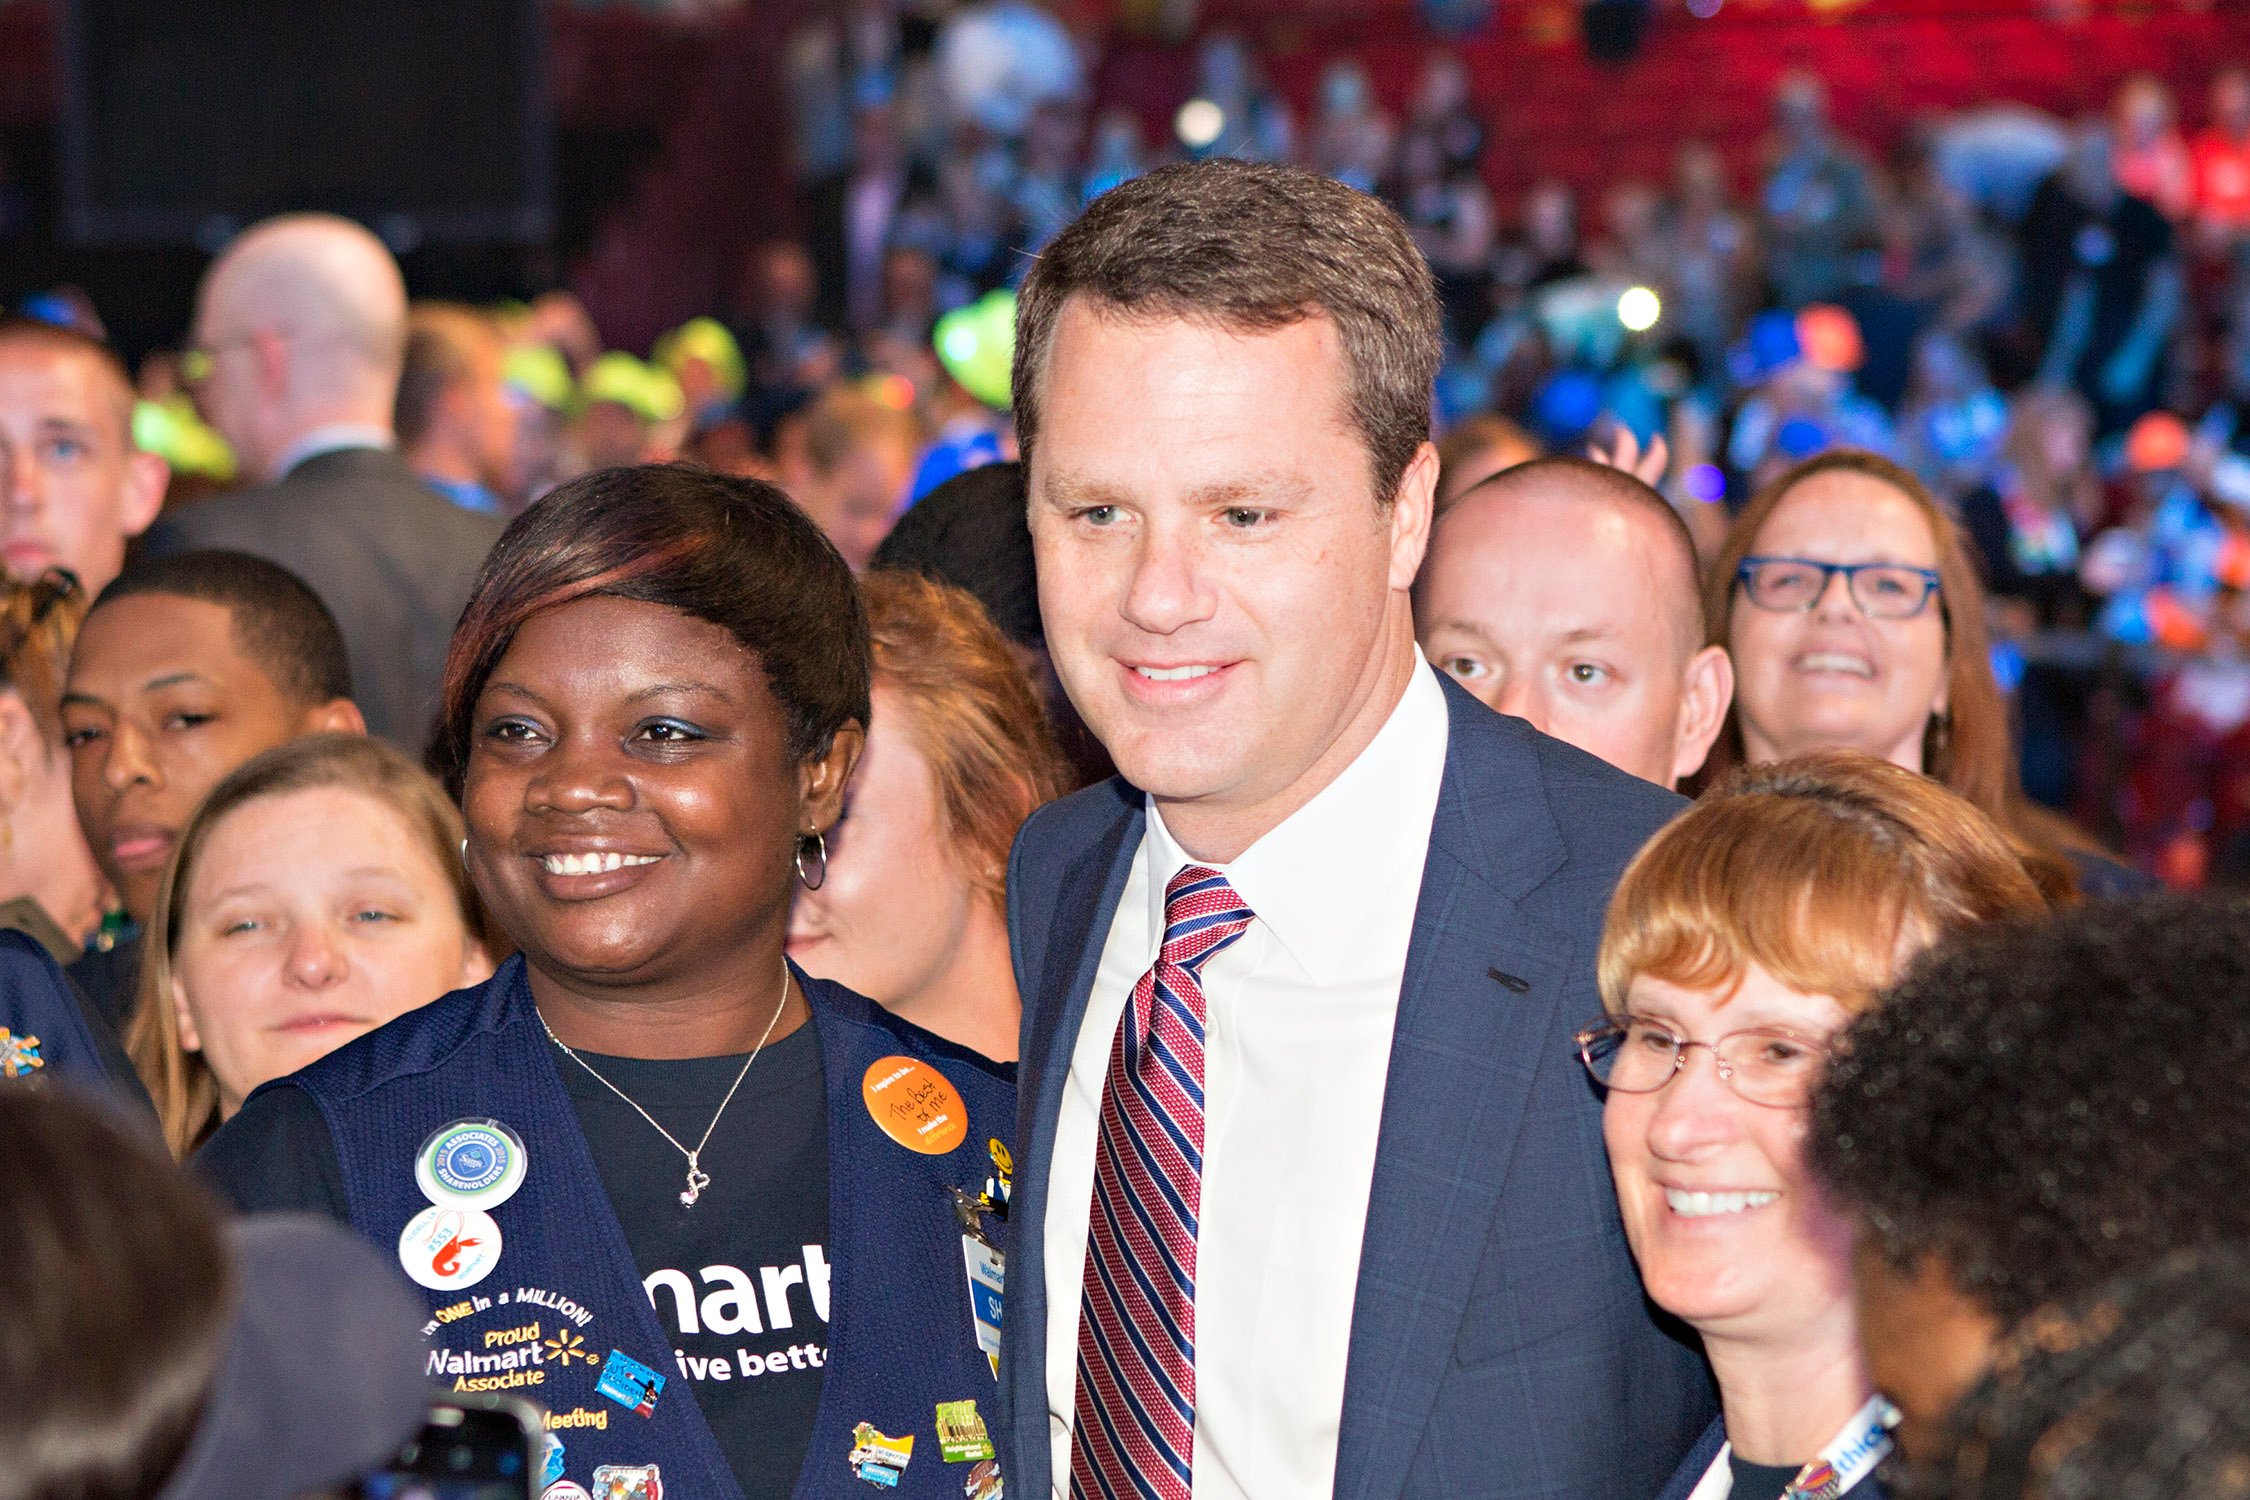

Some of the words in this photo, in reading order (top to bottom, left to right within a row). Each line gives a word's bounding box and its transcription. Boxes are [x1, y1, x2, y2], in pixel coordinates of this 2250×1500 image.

[889, 1100, 916, 1121] The
[445, 1131, 500, 1151] ASSOCIATES
[438, 1165, 505, 1190] SHAREHOLDERS
[427, 1227, 453, 1252] #553
[435, 1301, 475, 1324] ONE
[498, 1292, 511, 1305] a
[515, 1287, 593, 1328] MILLION!
[484, 1321, 541, 1349] Proud
[736, 1343, 828, 1378] bett
[453, 1368, 545, 1393] Associate
